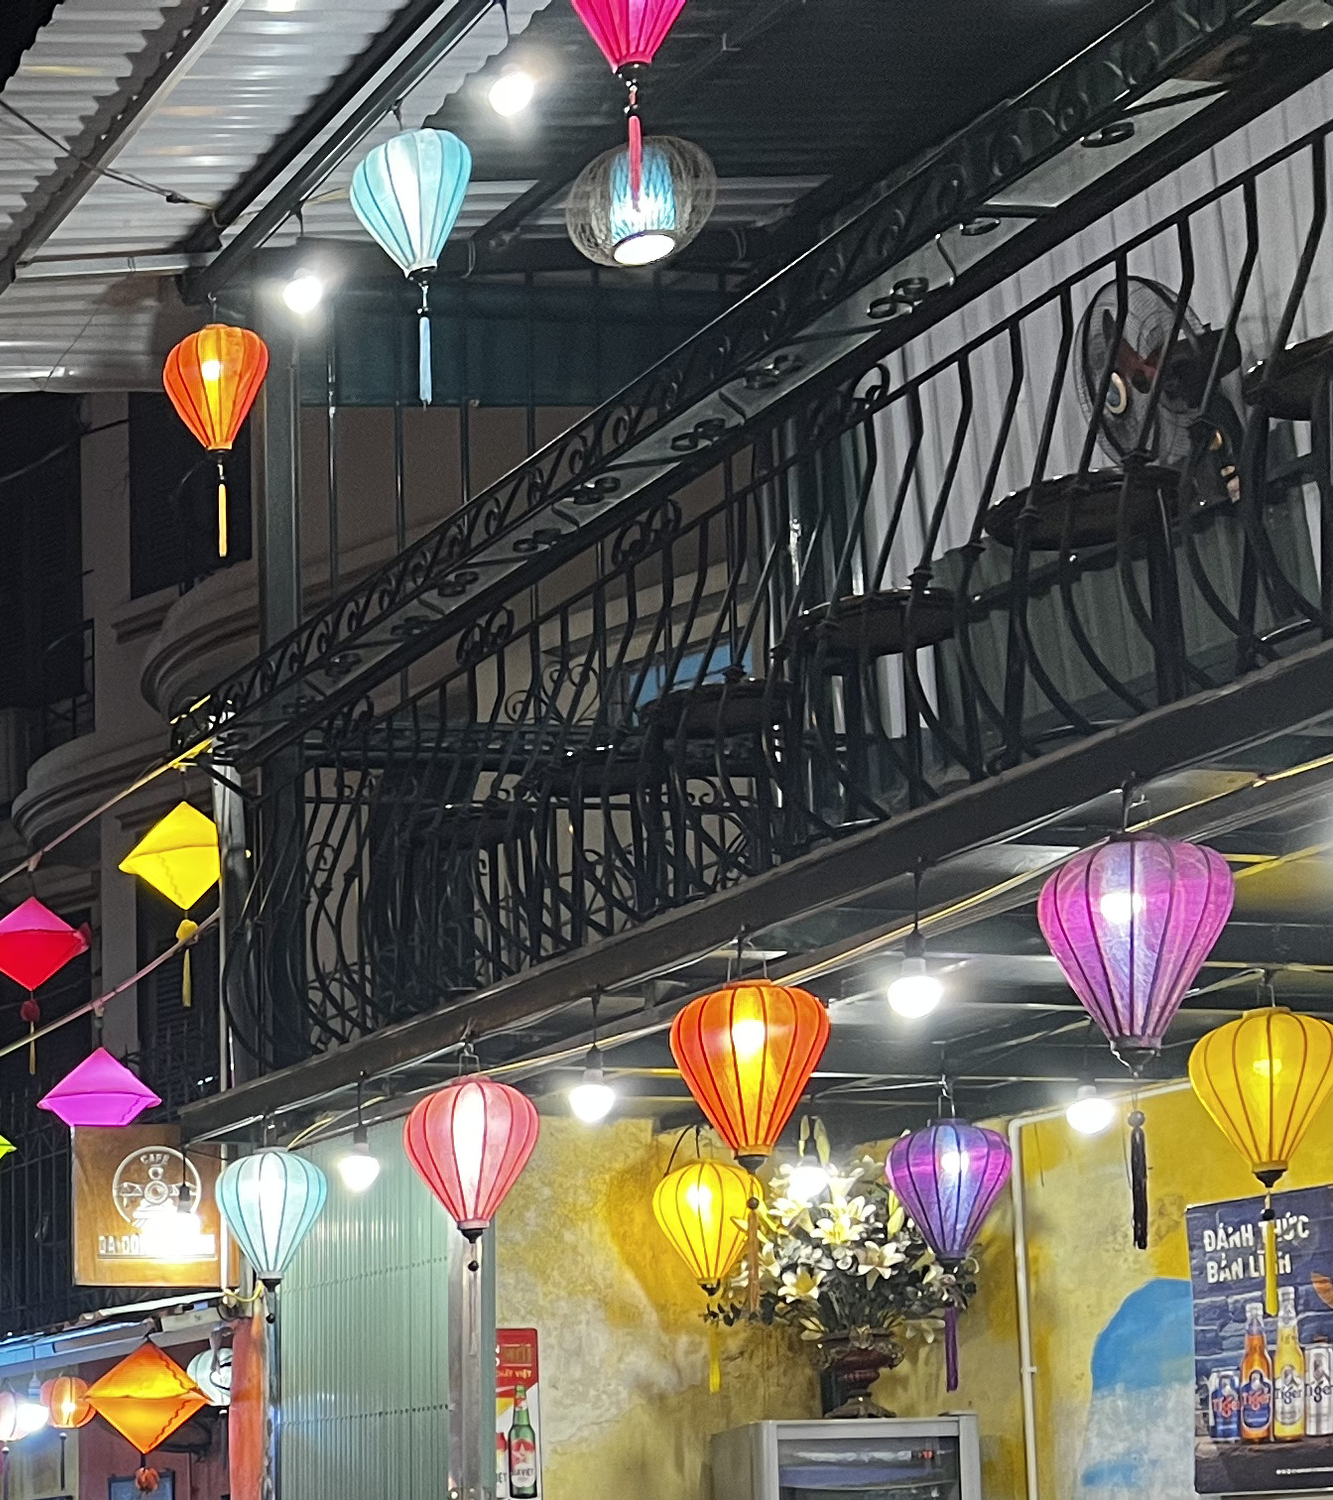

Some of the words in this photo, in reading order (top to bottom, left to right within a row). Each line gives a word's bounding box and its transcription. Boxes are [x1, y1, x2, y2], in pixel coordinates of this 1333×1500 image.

[140, 1153, 170, 1166] CAFE
[1203, 1222, 1254, 1252] ĐÁNH
[1206, 1252, 1244, 1284] BẢN
[1249, 1249, 1292, 1278] LĨH
[1304, 1381, 1333, 1403] Tige
